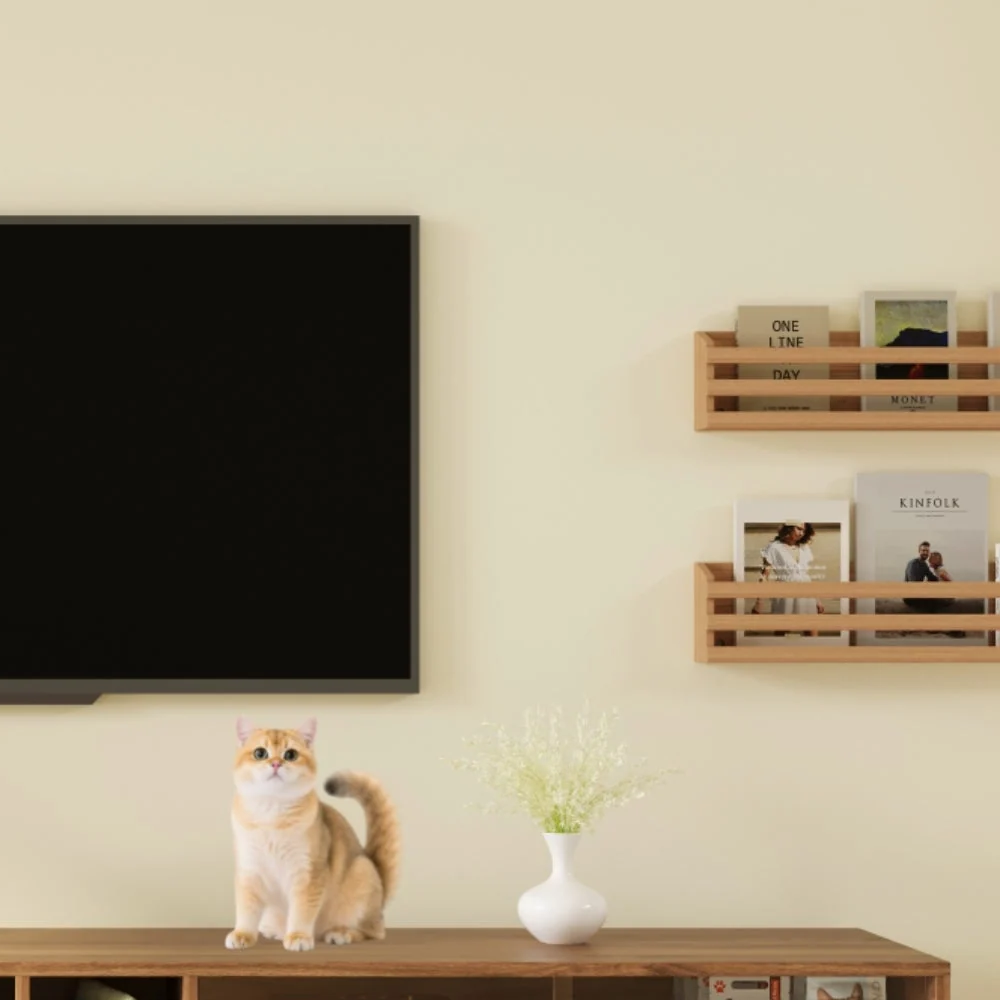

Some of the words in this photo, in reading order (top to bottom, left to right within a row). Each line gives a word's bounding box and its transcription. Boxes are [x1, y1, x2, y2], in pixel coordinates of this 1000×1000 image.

[772, 320, 799, 332] ONE
[768, 336, 804, 348] LINE
[773, 369, 800, 380] DAY
[890, 395, 935, 405] MONET
[899, 497, 960, 508] KINFOLK
